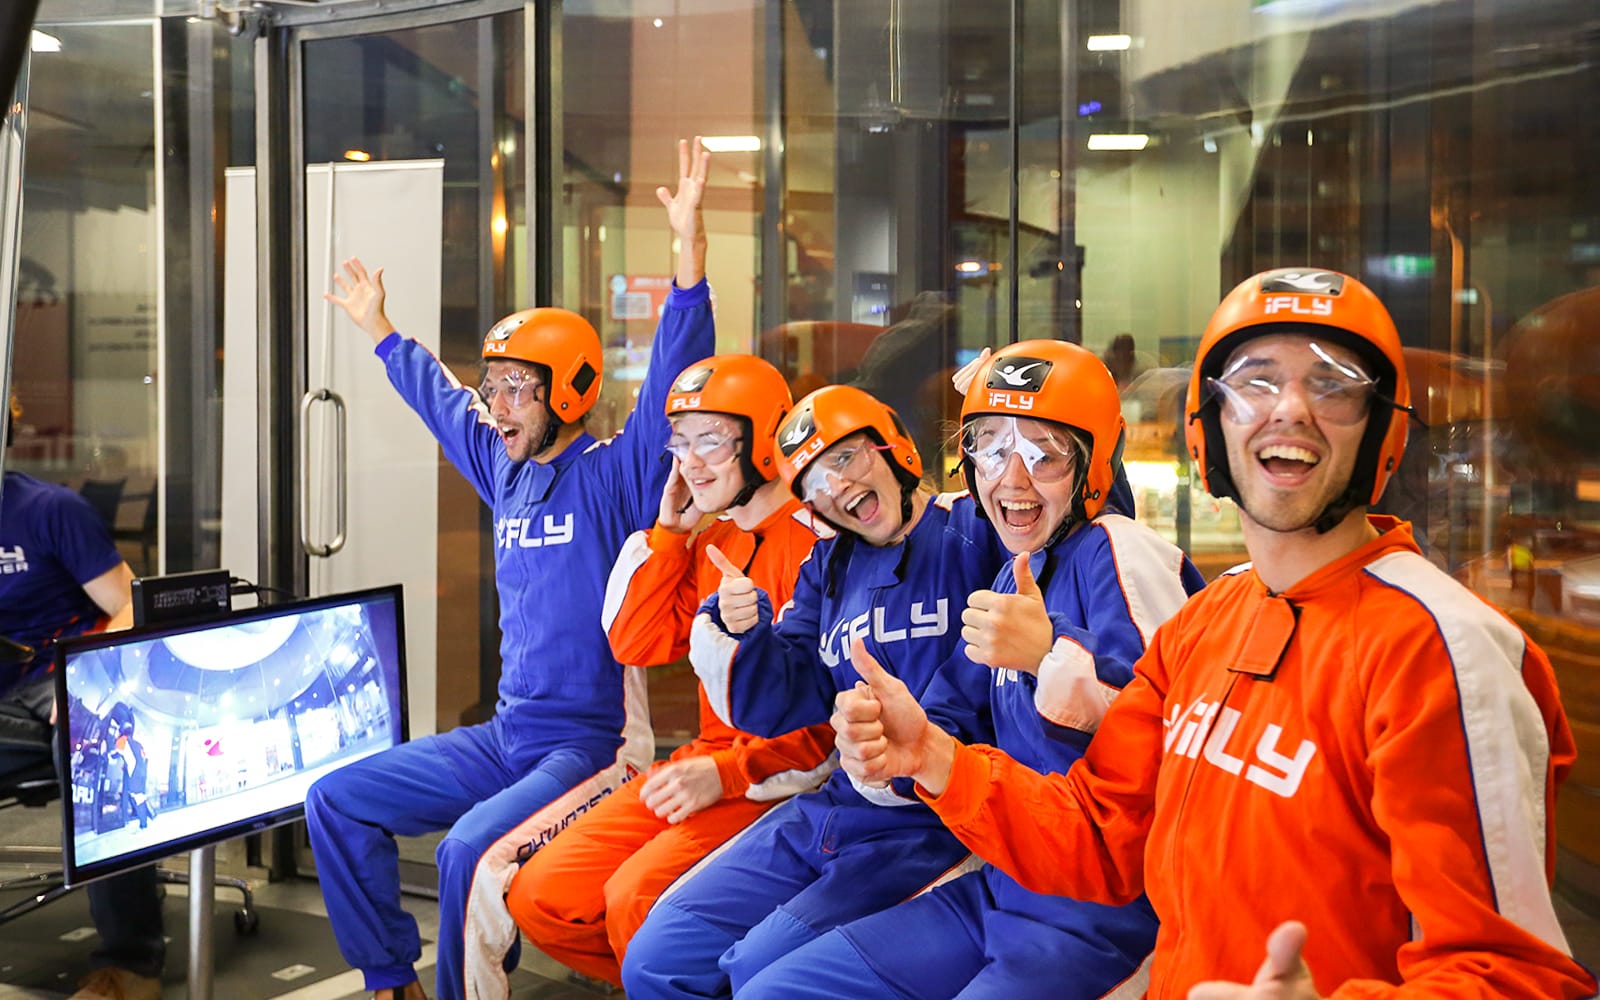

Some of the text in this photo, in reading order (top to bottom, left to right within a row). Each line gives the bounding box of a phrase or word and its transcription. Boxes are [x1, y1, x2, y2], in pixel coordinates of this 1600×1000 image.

[1264, 296, 1332, 316] iFLY
[988, 392, 1034, 410] iFLY
[840, 598, 949, 660] iFLY
